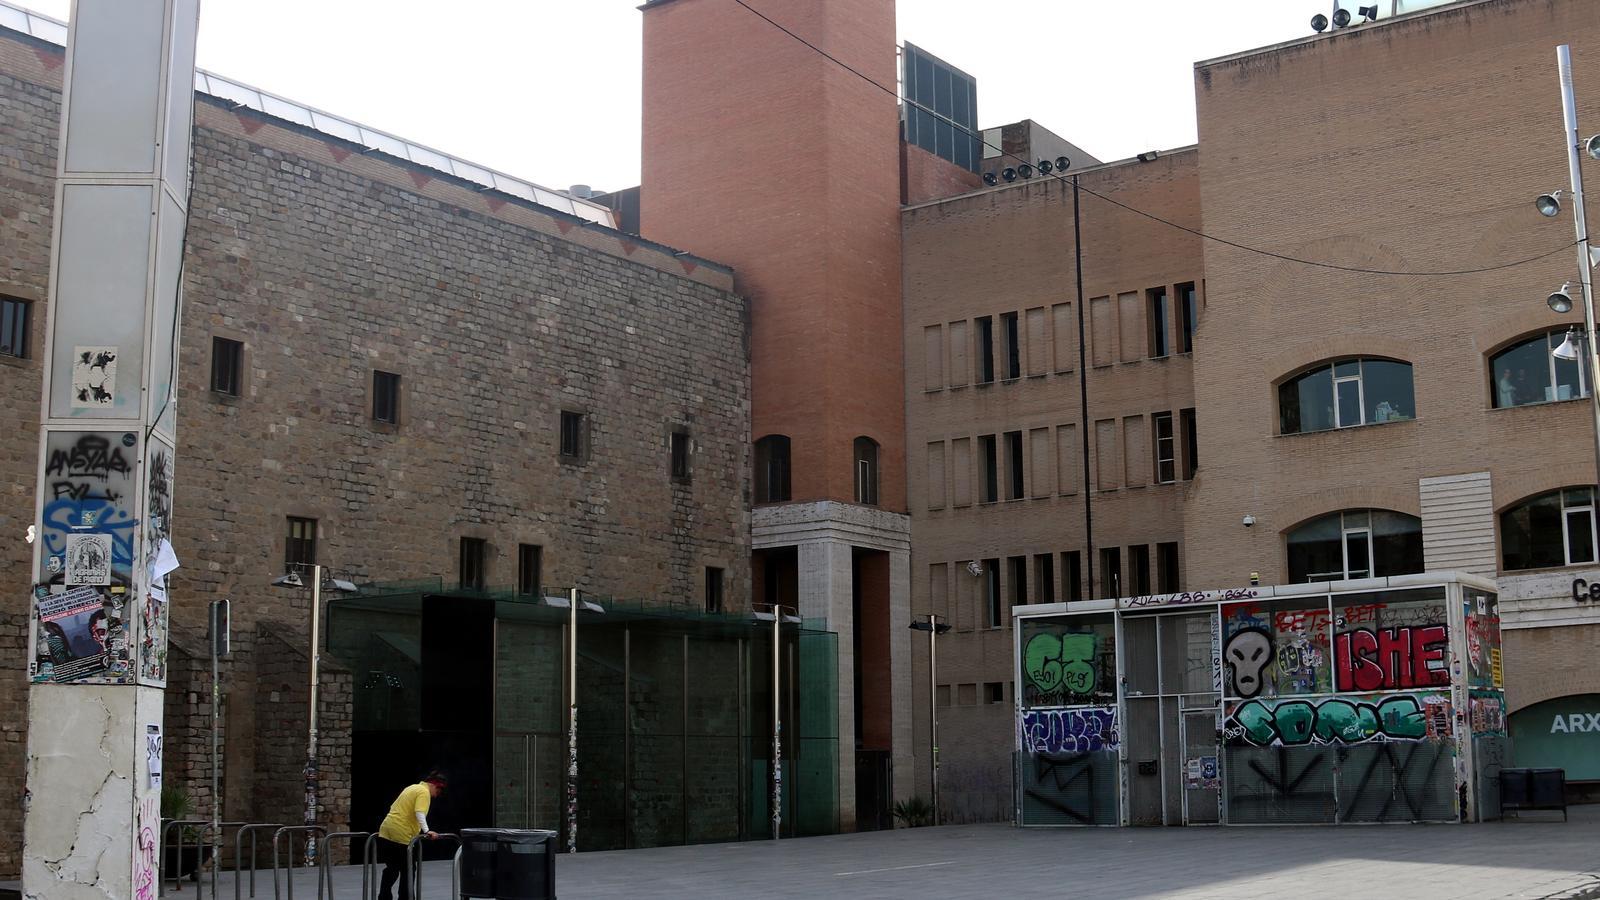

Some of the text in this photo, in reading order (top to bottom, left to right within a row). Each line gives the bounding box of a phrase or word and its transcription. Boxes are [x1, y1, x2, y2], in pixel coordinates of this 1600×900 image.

[43, 598, 100, 616] ACCIÓ DIRECTA
[1550, 713, 1600, 734] ARX
